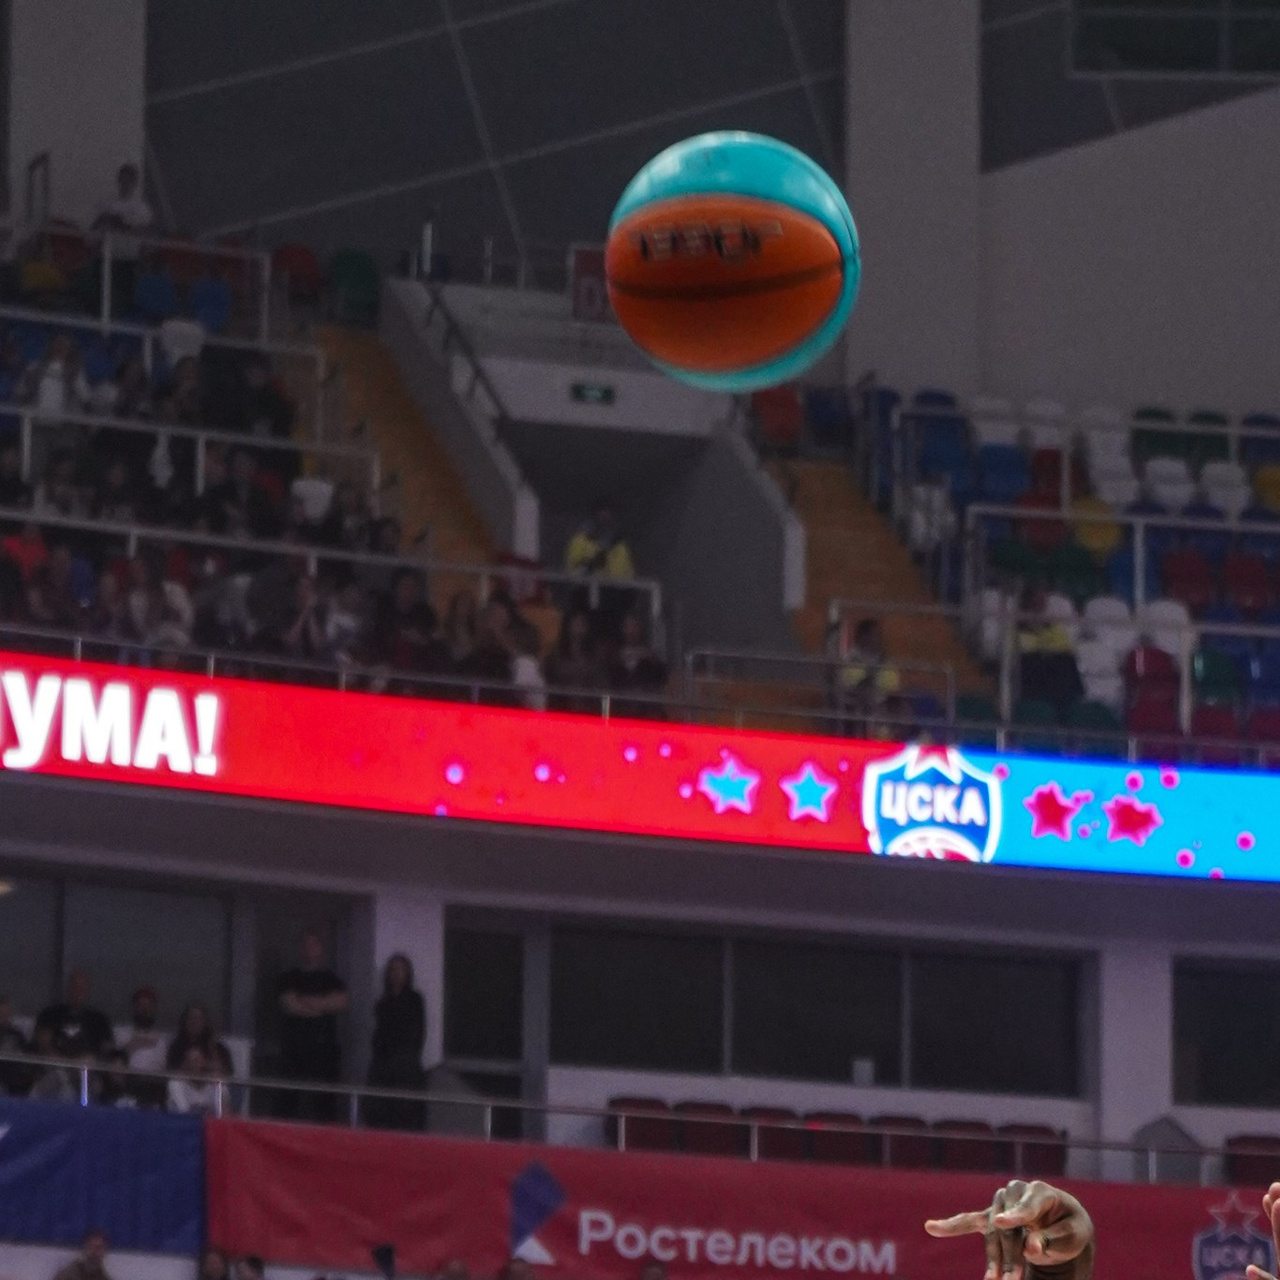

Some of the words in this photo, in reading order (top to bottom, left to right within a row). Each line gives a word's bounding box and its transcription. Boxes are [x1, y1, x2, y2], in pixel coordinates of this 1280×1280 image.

[0, 670, 219, 776] УМА!
[879, 780, 988, 827] ЦСКА
[578, 1209, 897, 1275] Ростелеком
